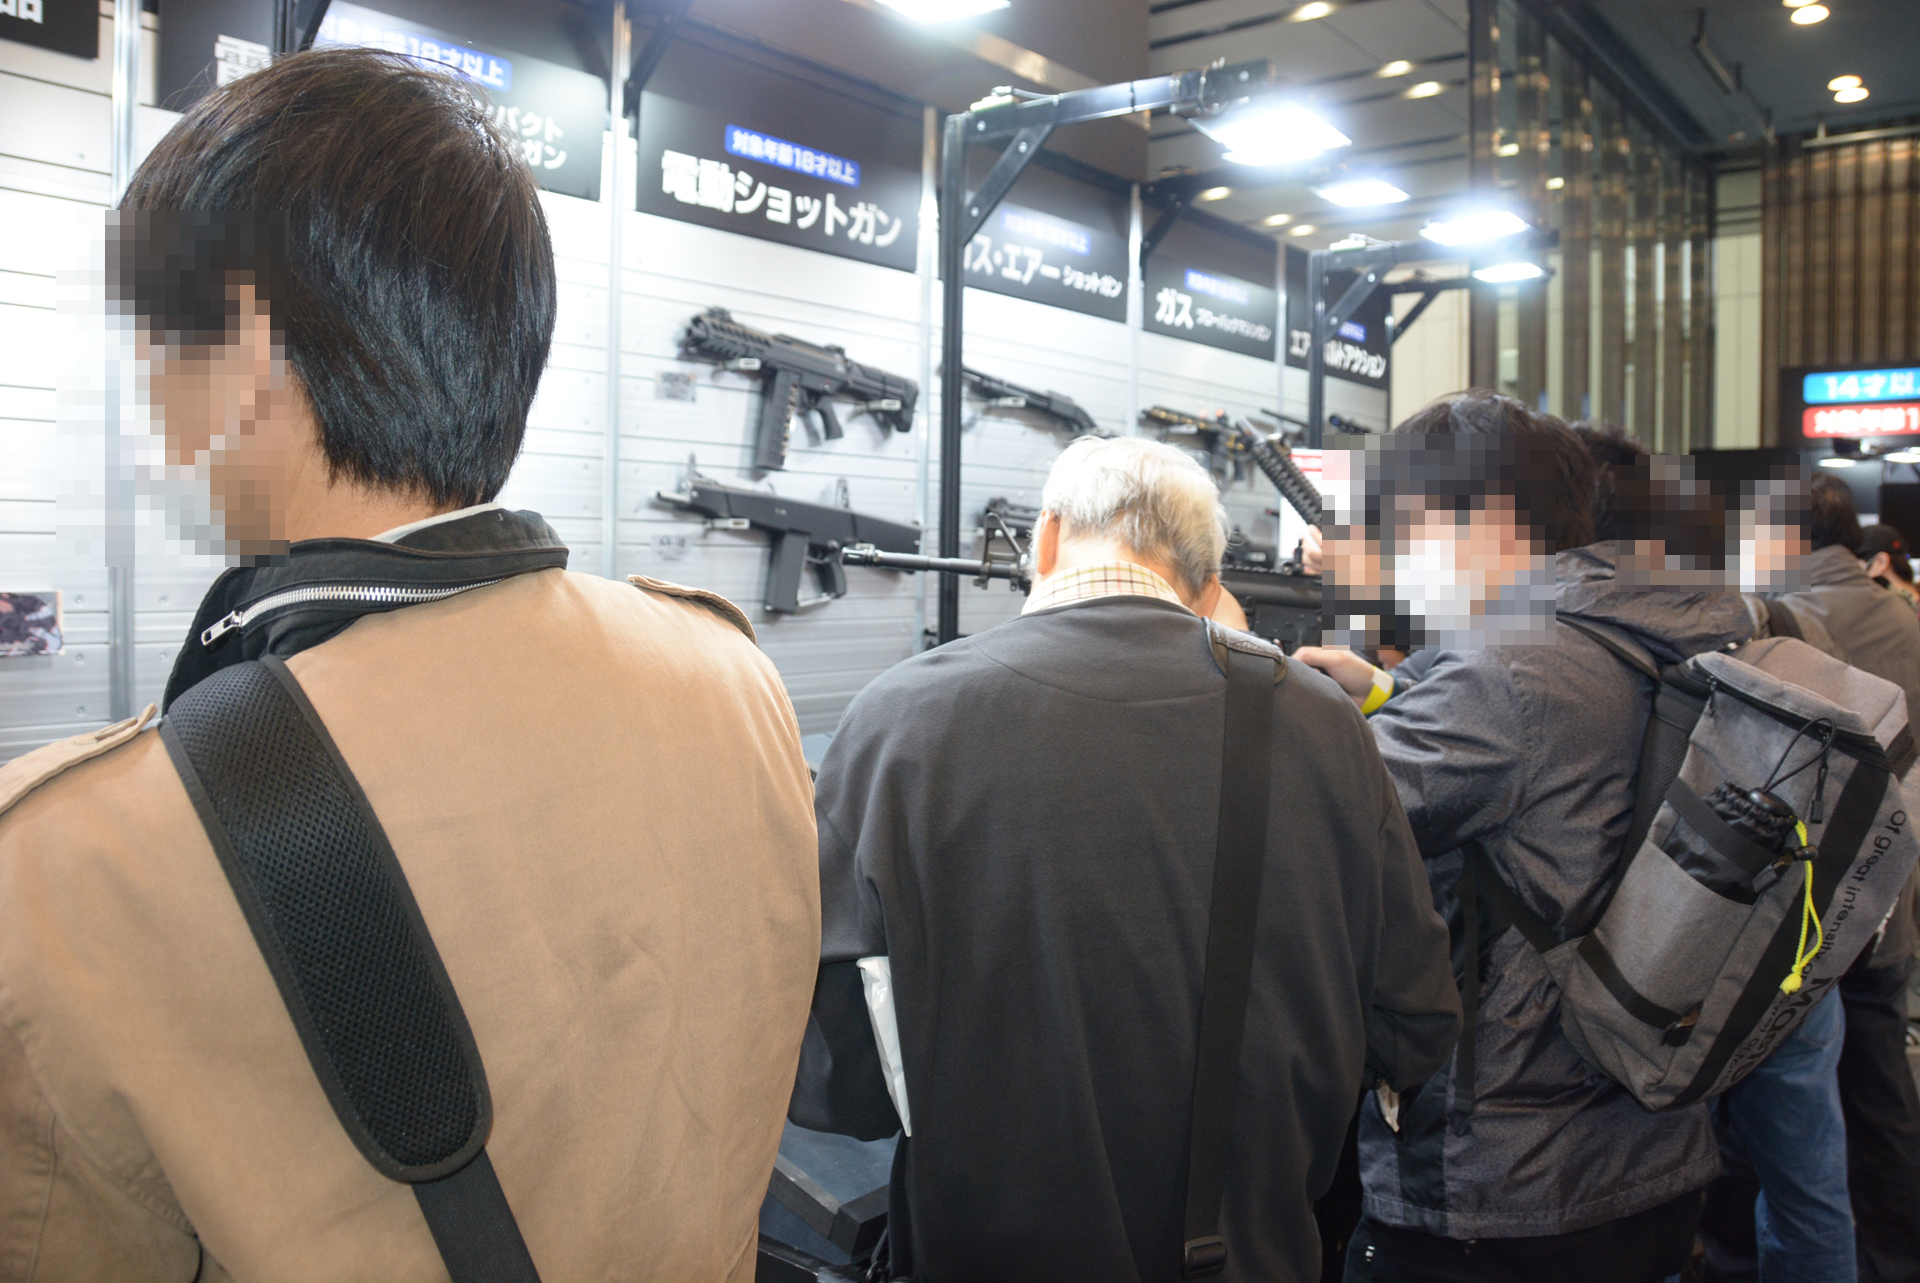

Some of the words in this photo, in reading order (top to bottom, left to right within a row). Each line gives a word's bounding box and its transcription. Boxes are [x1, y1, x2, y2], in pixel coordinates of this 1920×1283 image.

[661, 149, 902, 248] 電動ショットガン
[1155, 286, 1194, 330] ガス
[1824, 371, 1920, 400] 14才以
[1885, 810, 1907, 835] Of
[1853, 834, 1892, 882] great
